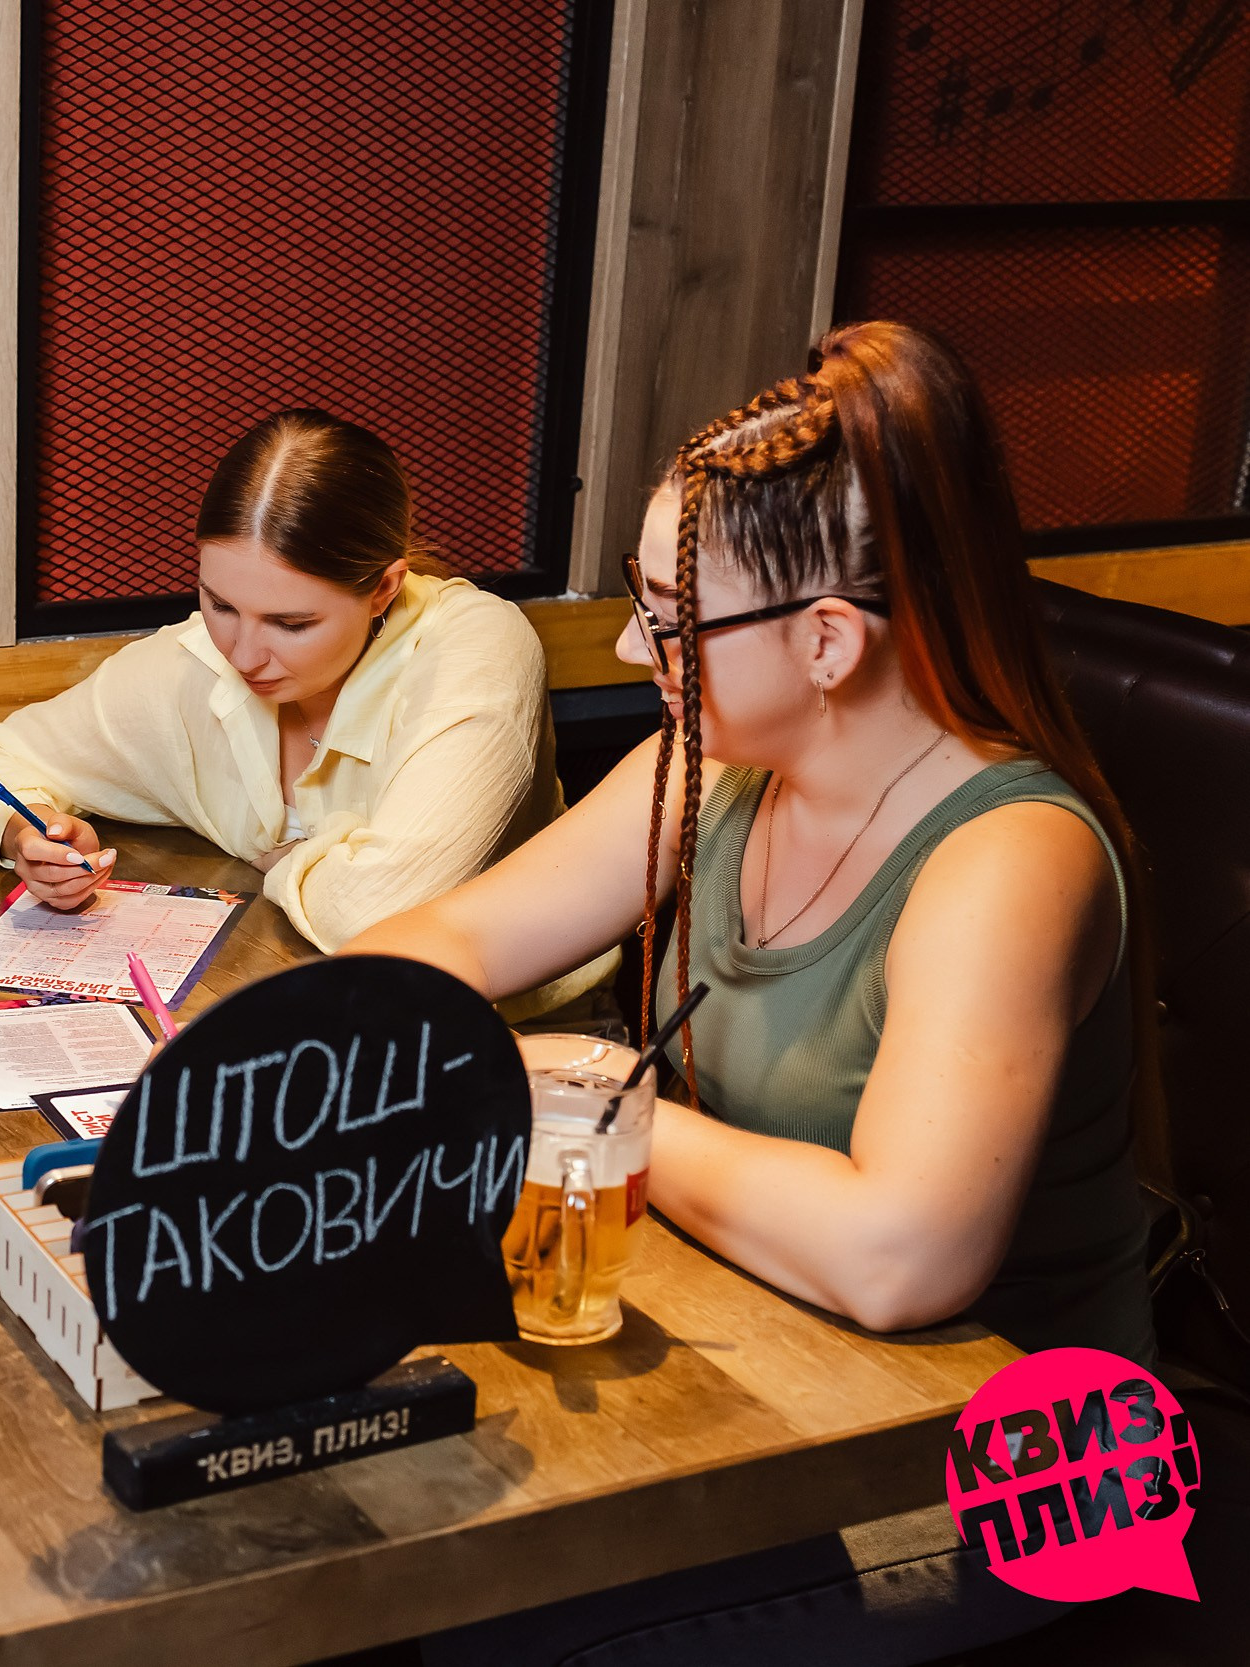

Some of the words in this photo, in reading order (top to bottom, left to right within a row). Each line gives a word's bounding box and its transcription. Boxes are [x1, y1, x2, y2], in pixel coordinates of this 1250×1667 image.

[19, 979, 87, 993] ПРОСТО
[78, 981, 113, 991] ДЛЯ
[88, 985, 109, 995] НЕ
[133, 1021, 474, 1178] ШТОШ-
[85, 1134, 526, 1321] ТАКОВИЧИ
[206, 1435, 303, 1483] КВИЗ,
[314, 1407, 411, 1456] ПЛИЗ!
